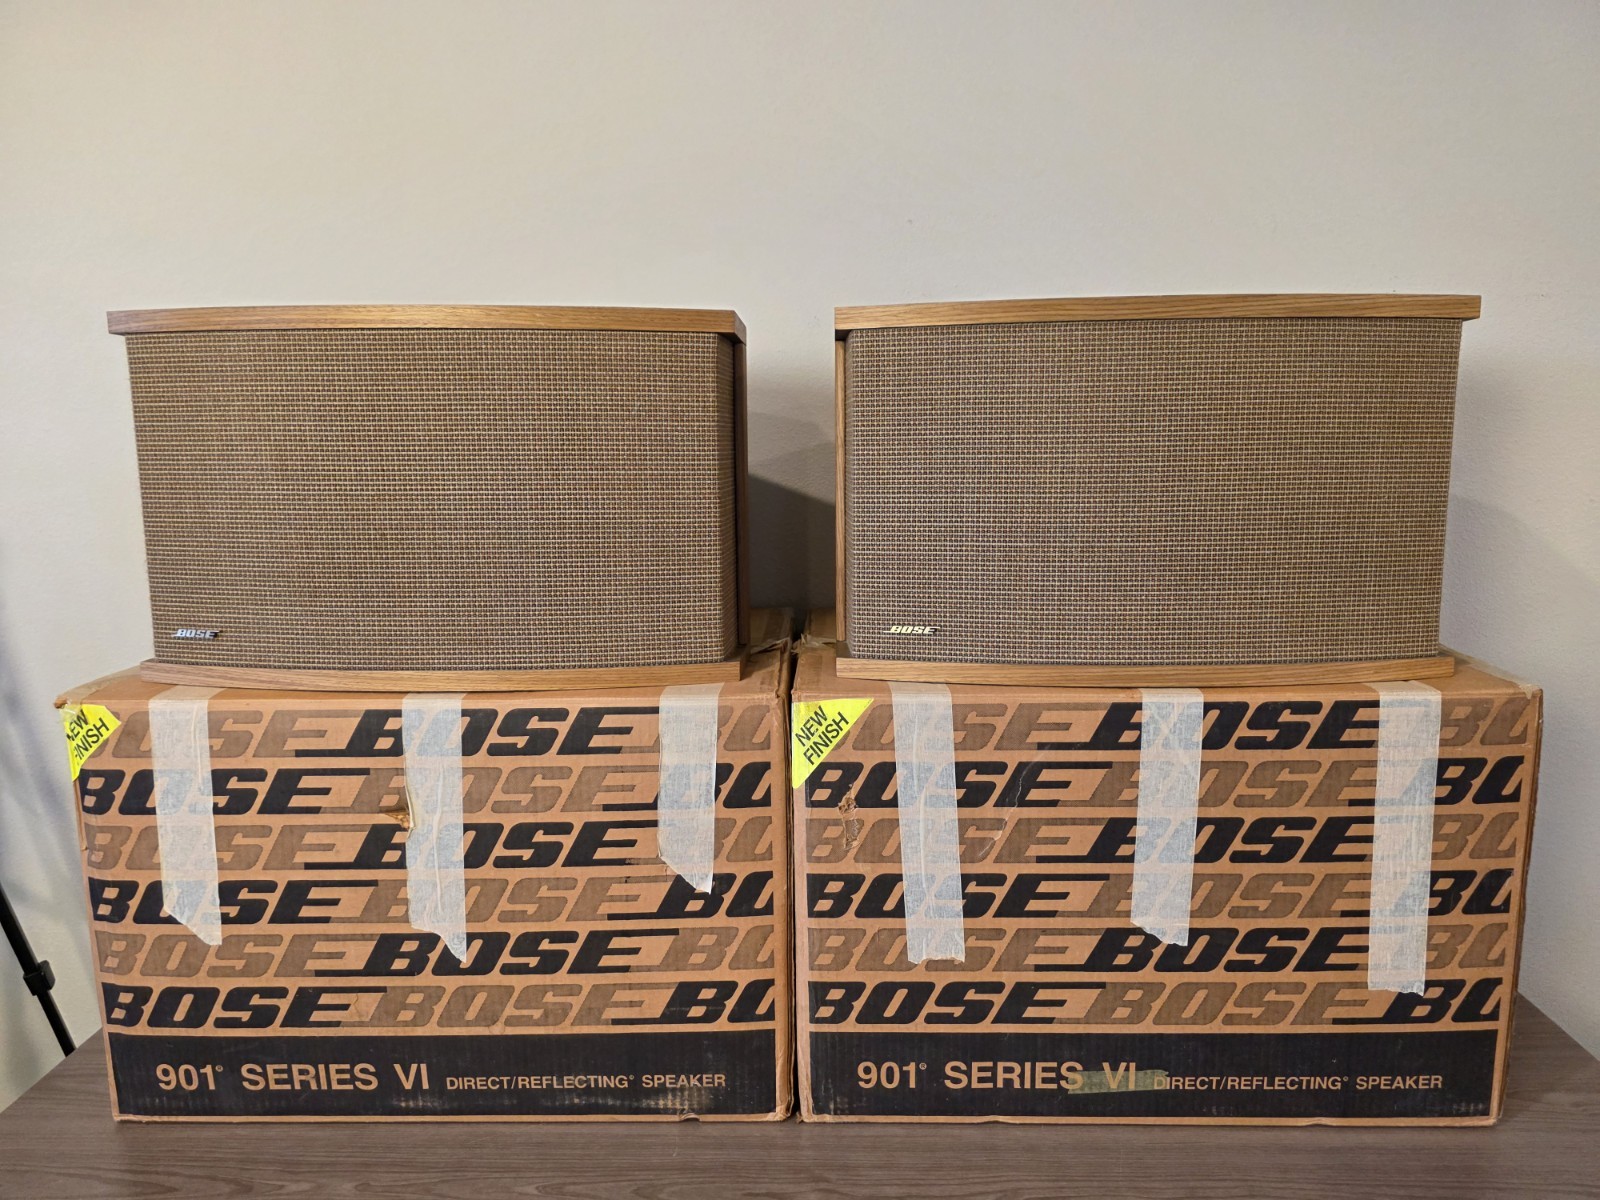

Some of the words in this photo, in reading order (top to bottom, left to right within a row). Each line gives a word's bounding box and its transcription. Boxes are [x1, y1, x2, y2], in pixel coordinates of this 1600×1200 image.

[171, 628, 222, 639] BOSE
[882, 625, 941, 635] BOSE
[74, 717, 110, 761] INISH
[795, 705, 828, 747] NEW
[803, 711, 850, 766] FINISH
[77, 767, 371, 816] BOSE
[805, 760, 1113, 809] BOSE
[303, 818, 677, 870] BOSE
[805, 817, 1108, 864] BOSE
[87, 876, 379, 925] BOSE
[806, 873, 1111, 919] BOSE
[94, 930, 381, 978] BOSE
[313, 927, 680, 977] BOSE
[807, 927, 1108, 972] BOSE
[1034, 926, 1410, 973] BOSE
[101, 980, 388, 1029] BOSE
[340, 981, 679, 1028] BOSE
[808, 980, 1107, 1025] BOSE
[1053, 981, 1404, 1026] BOSE
[241, 1063, 378, 1091] SERIES
[393, 1063, 430, 1090] VI
[641, 1073, 727, 1089] SPEAKER
[944, 1061, 1084, 1090] SERIES
[1102, 1062, 1136, 1090] VI
[1356, 1074, 1443, 1090] SPEAKER
